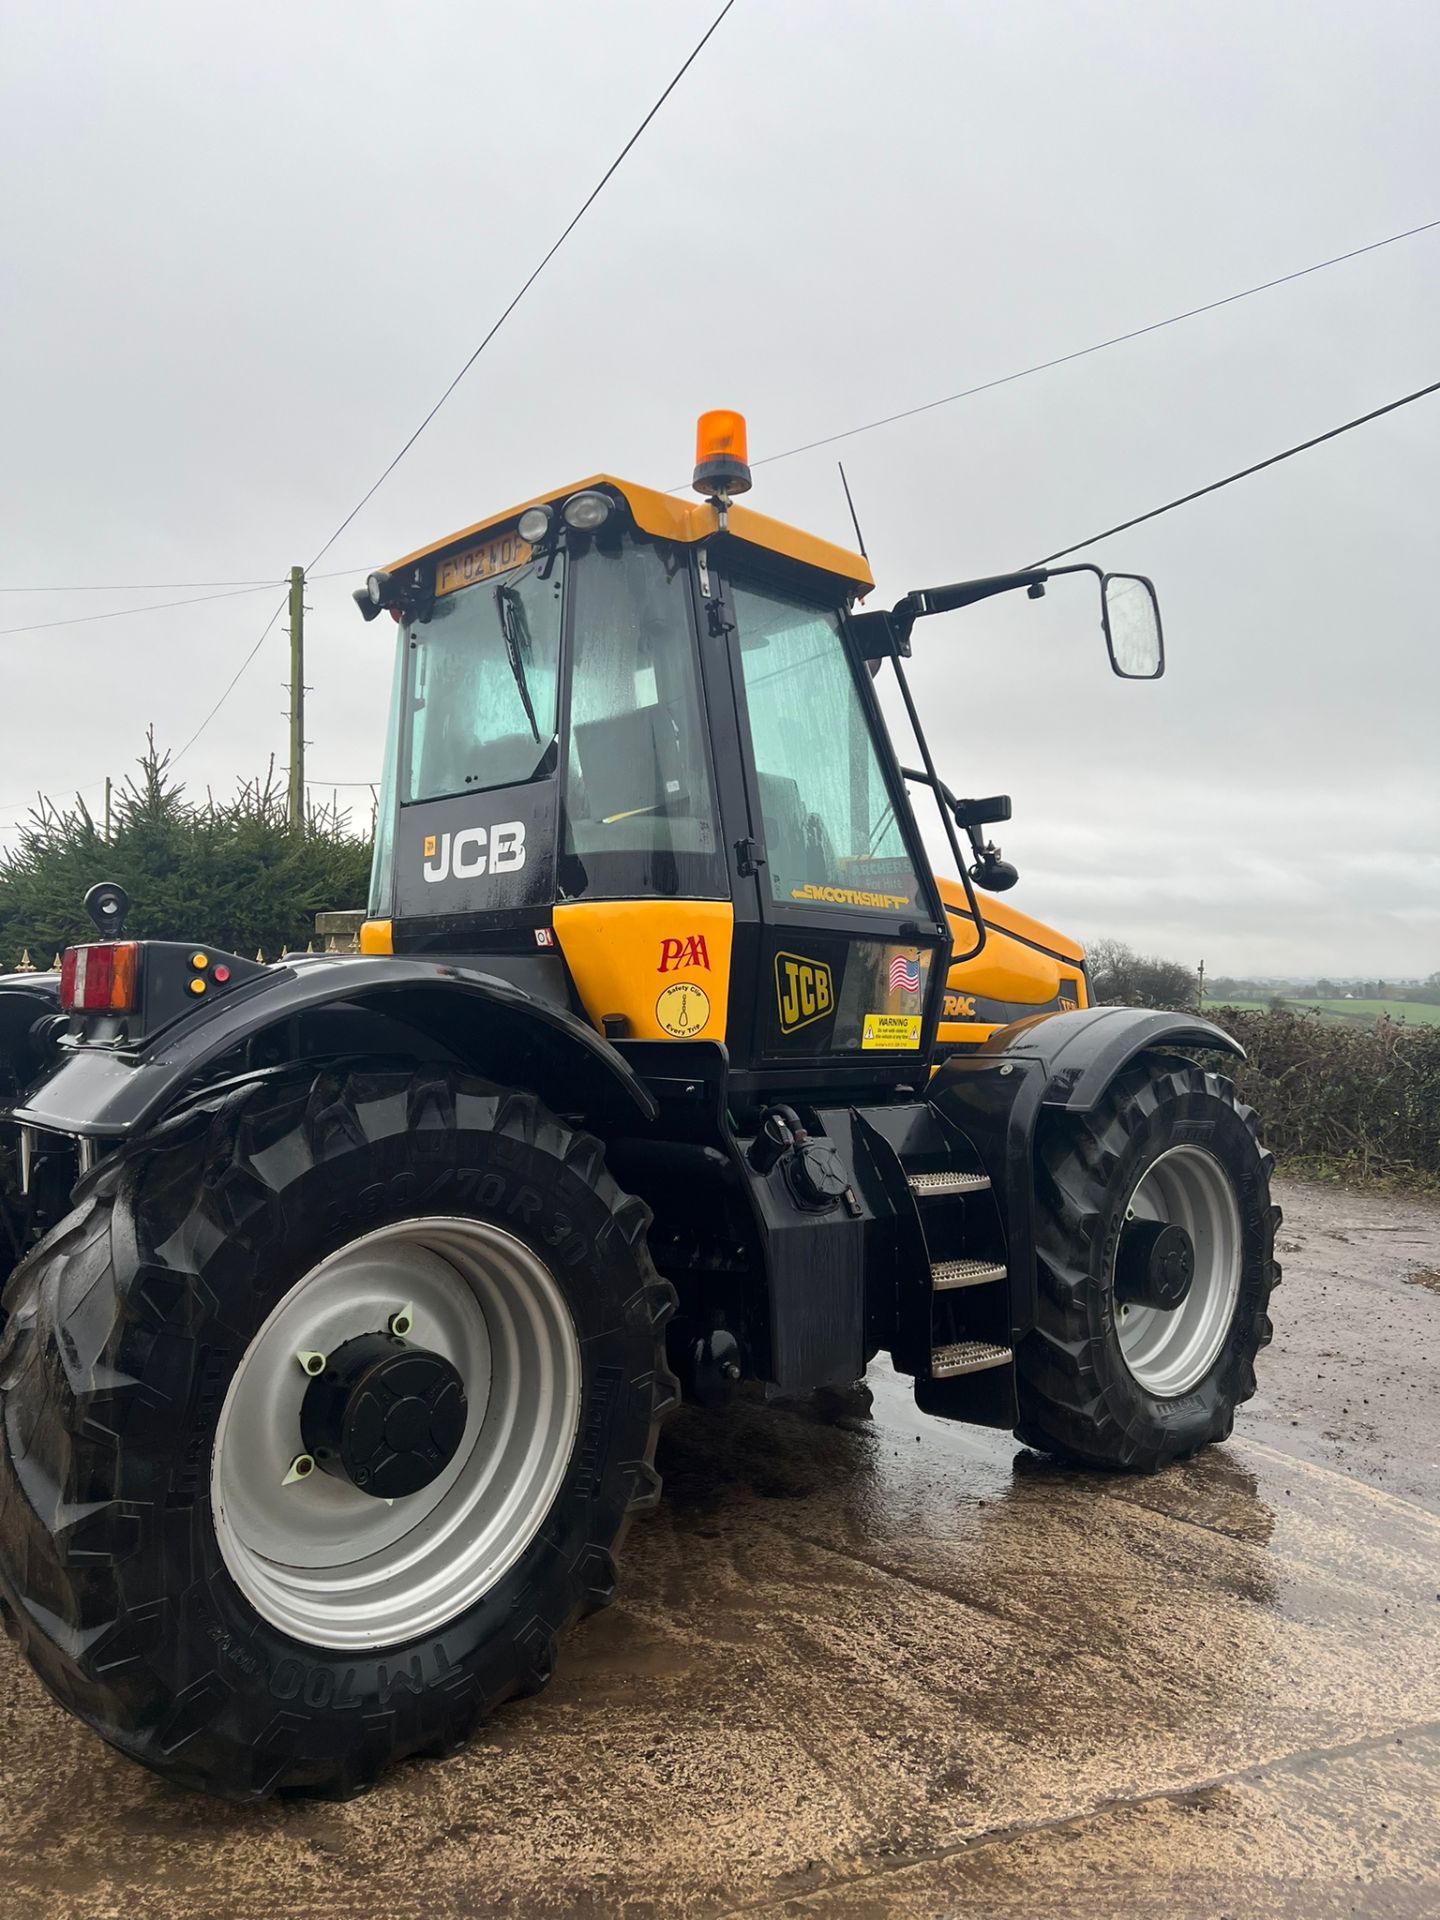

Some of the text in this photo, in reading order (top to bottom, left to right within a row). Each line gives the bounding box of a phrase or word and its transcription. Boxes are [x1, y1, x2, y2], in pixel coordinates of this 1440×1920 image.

[423, 821, 526, 883] JCB
[667, 985, 702, 997] Safety Clip
[783, 961, 829, 1024] JCB
[878, 1018, 908, 1027] WARNING
[666, 1024, 700, 1035] Every Trip
